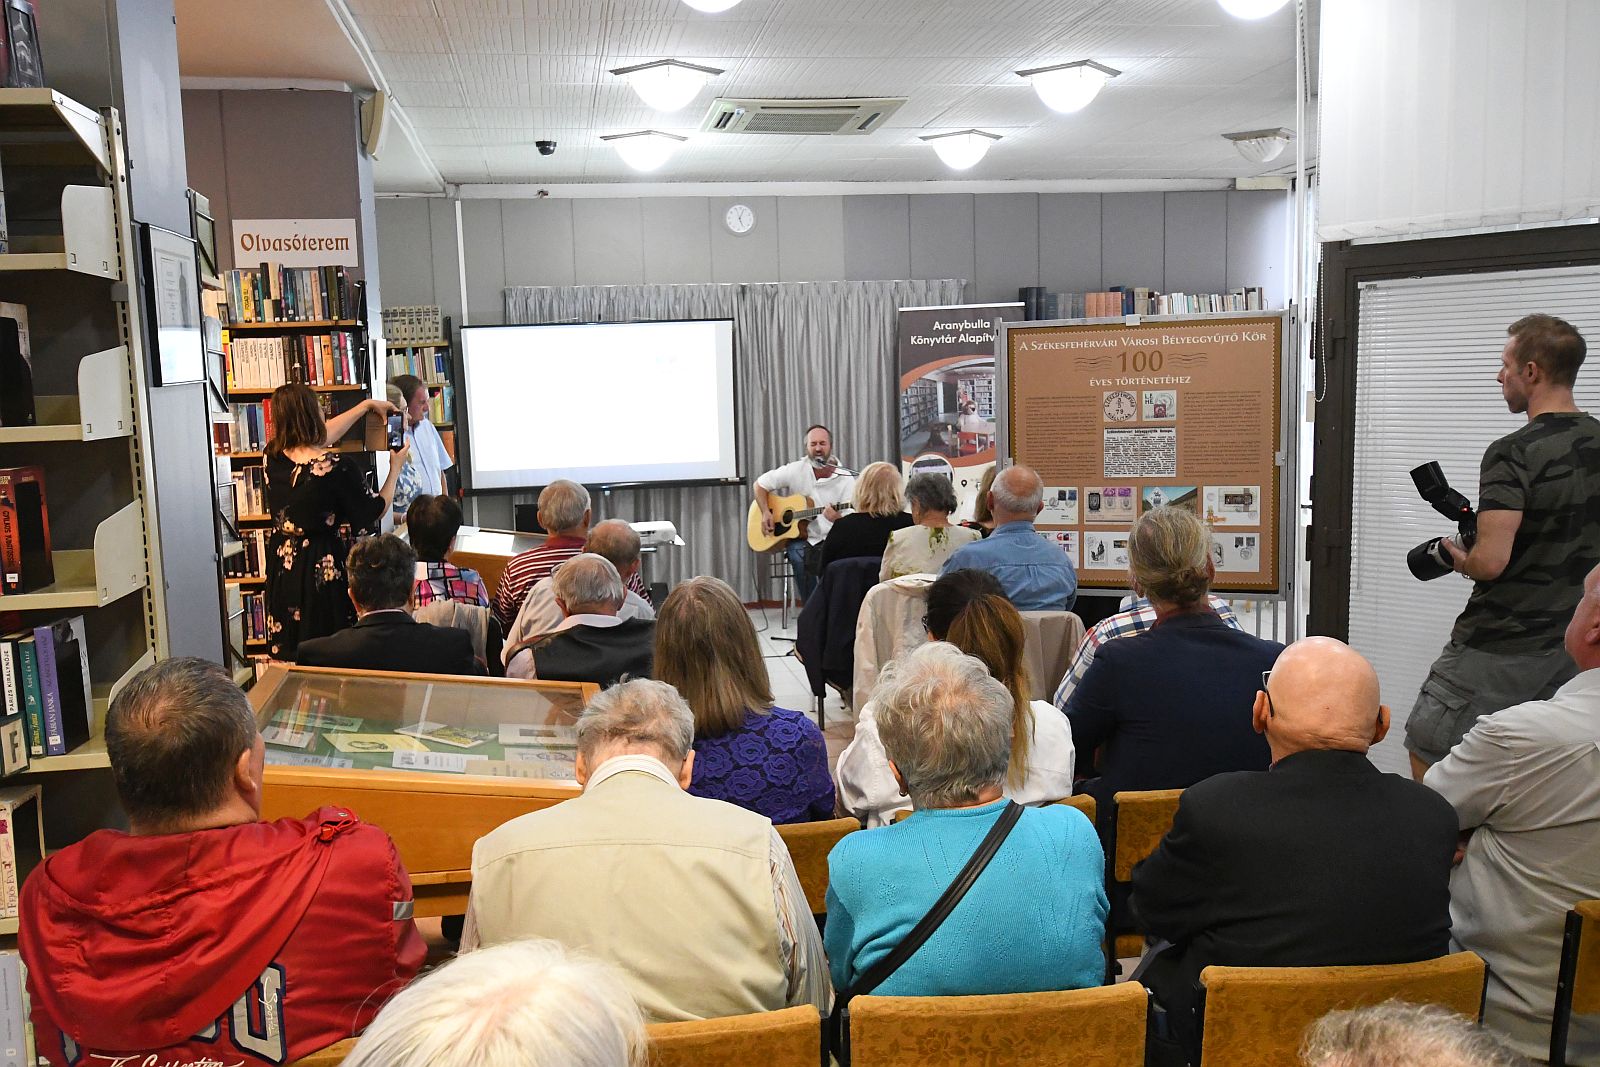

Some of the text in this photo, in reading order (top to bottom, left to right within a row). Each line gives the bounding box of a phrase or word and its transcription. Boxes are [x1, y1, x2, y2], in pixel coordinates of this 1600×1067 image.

[241, 233, 350, 252] Olvasóterem
[933, 319, 991, 331] Aranybulla
[910, 334, 957, 346] Könyvtár
[1019, 341, 1028, 351] A
[1031, 339, 1118, 350] SZÉKESFEHÉRVÁRI
[1121, 336, 1158, 347] VÁROSI
[1243, 331, 1267, 342] KÖR
[1117, 350, 1164, 373] 100
[1090, 374, 1192, 387] ÉVES TÖRTÉNETÉHEZ
[9, 729, 19, 764] F
